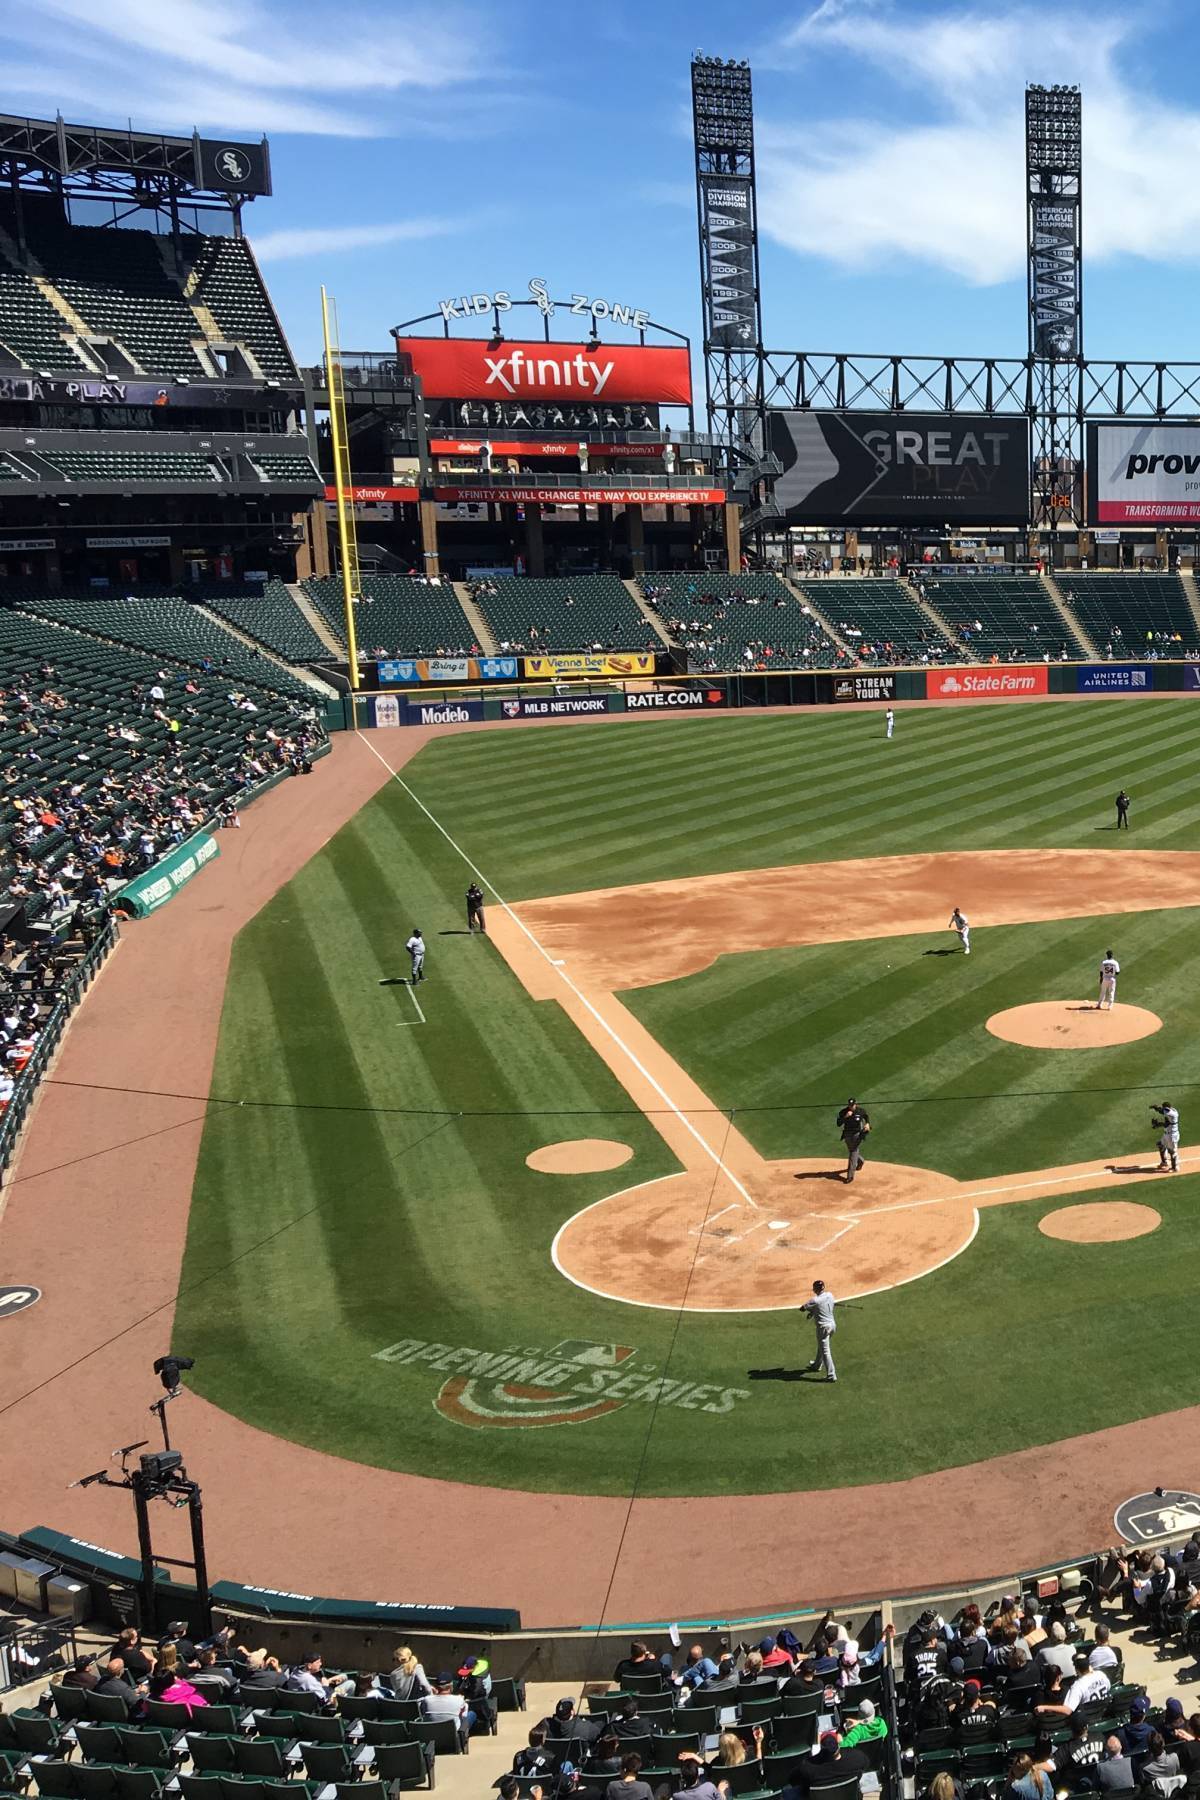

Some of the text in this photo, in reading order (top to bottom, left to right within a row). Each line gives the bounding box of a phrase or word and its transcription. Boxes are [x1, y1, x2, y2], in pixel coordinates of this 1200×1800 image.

[707, 193, 747, 202] DIVISION
[708, 200, 747, 208] CHAMPIONS
[1036, 213, 1073, 222] LEAGUE
[440, 291, 650, 331] KIDS ZONE
[483, 350, 615, 396] xfinity
[69, 382, 126, 399] PLAY
[542, 444, 568, 454] xfinity
[609, 446, 655, 455] xfinity.com/x1
[862, 430, 1009, 466] GREAT
[912, 465, 999, 491] PLAY
[355, 487, 388, 500] xfinity
[458, 490, 495, 500] XFINITY
[511, 490, 537, 500] WILL
[538, 490, 580, 500] CHANGE
[582, 490, 601, 500] THE
[602, 490, 625, 500] WAY
[626, 490, 646, 501] YOU
[648, 490, 698, 501] EXPERIENCE
[1125, 505, 1188, 517] TRANSFORMING
[431, 660, 466, 672] Bring it
[548, 656, 607, 668] Vienna Beef
[855, 678, 893, 688] STREAM
[627, 692, 703, 707] RATE.COM
[855, 689, 880, 698] YOUR
[525, 700, 605, 714] MLB NETWORK
[421, 706, 470, 724] Modelo
[370, 1339, 751, 1414] OPENING SERIES
[915, 1652, 938, 1662] THOME
[917, 1662, 938, 1676] 25
[1072, 1741, 1104, 1763] MONCADA
